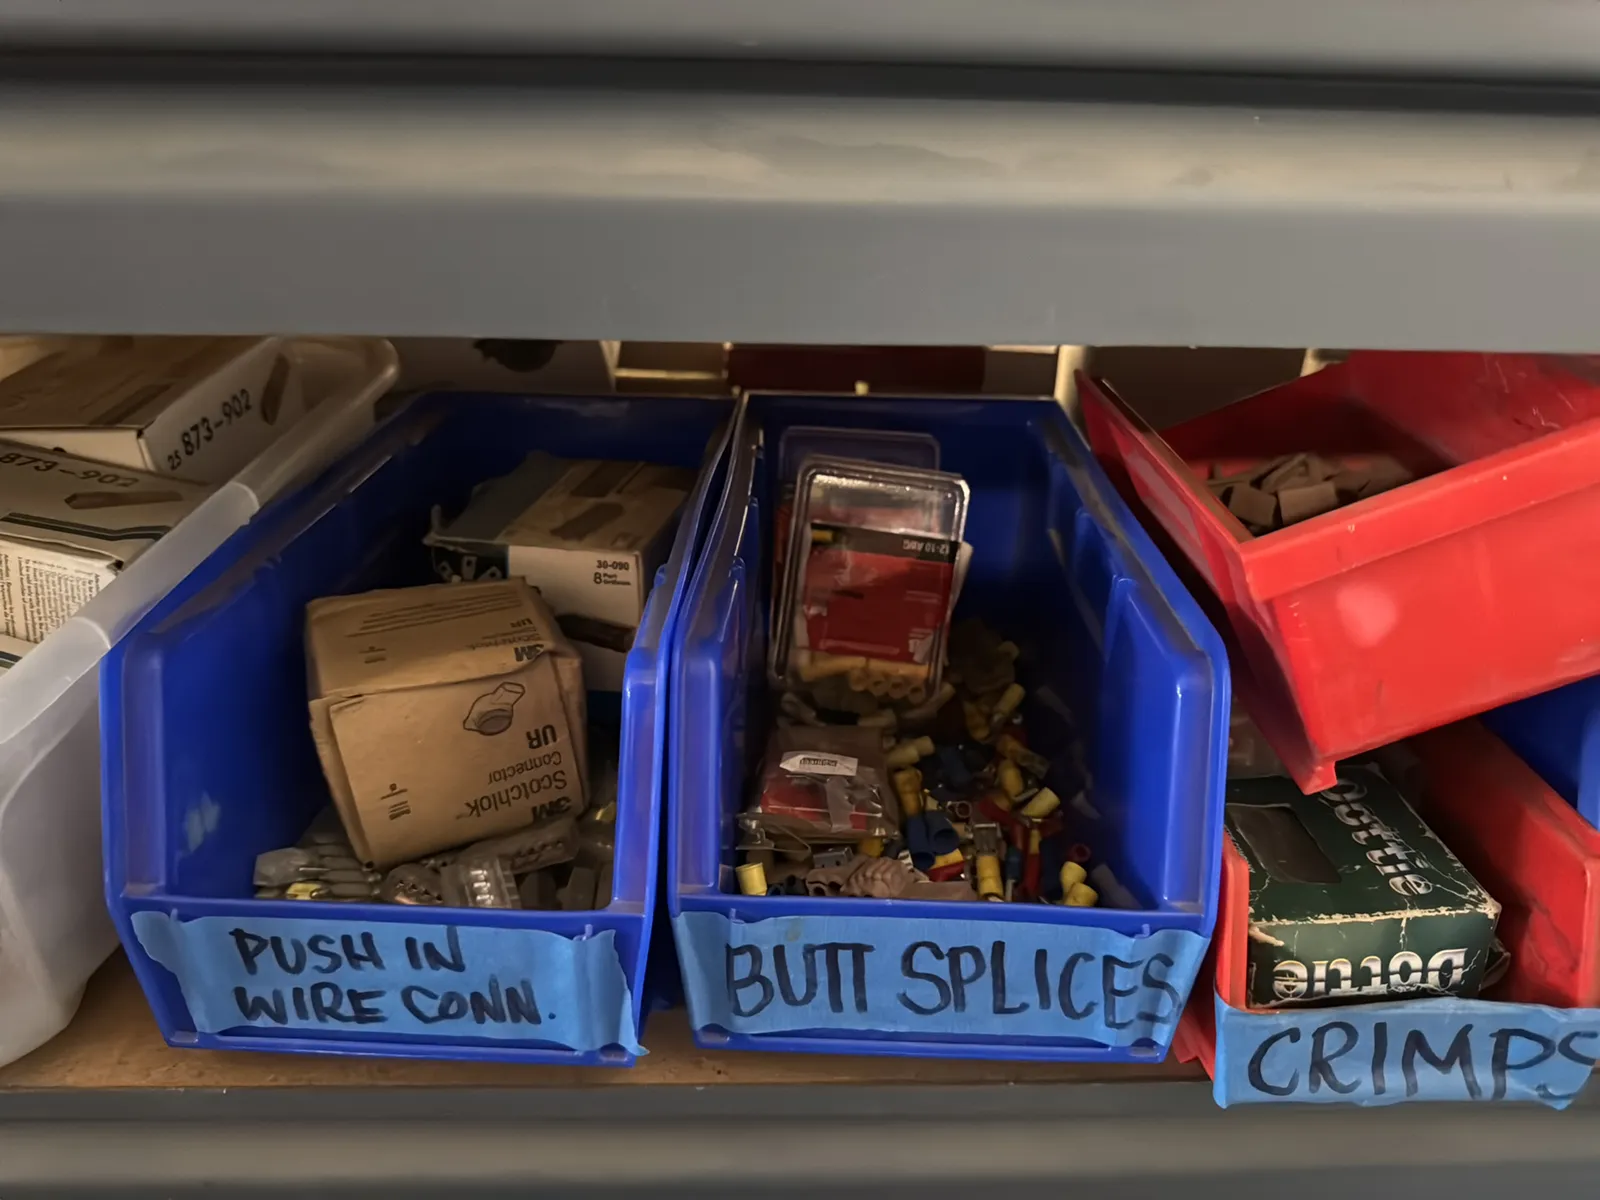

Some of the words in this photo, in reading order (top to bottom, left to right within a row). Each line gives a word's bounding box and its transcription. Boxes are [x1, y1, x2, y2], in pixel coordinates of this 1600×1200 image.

[180, 388, 253, 458] 873-902
[0, 452, 141, 488] 873-902
[526, 724, 557, 750] UR
[465, 769, 568, 818] Scotchlok
[487, 752, 562, 785] Connector
[532, 796, 573, 820] 3M
[229, 926, 385, 975] PUSH
[406, 925, 466, 973] IN
[1272, 947, 1469, 999] Dottie
[233, 981, 390, 1025] WIRE
[401, 973, 556, 1026] CONN.
[725, 941, 875, 1018] BUTT
[896, 940, 1182, 1030] SPLICES
[1248, 1021, 1598, 1101] CRIMPS
